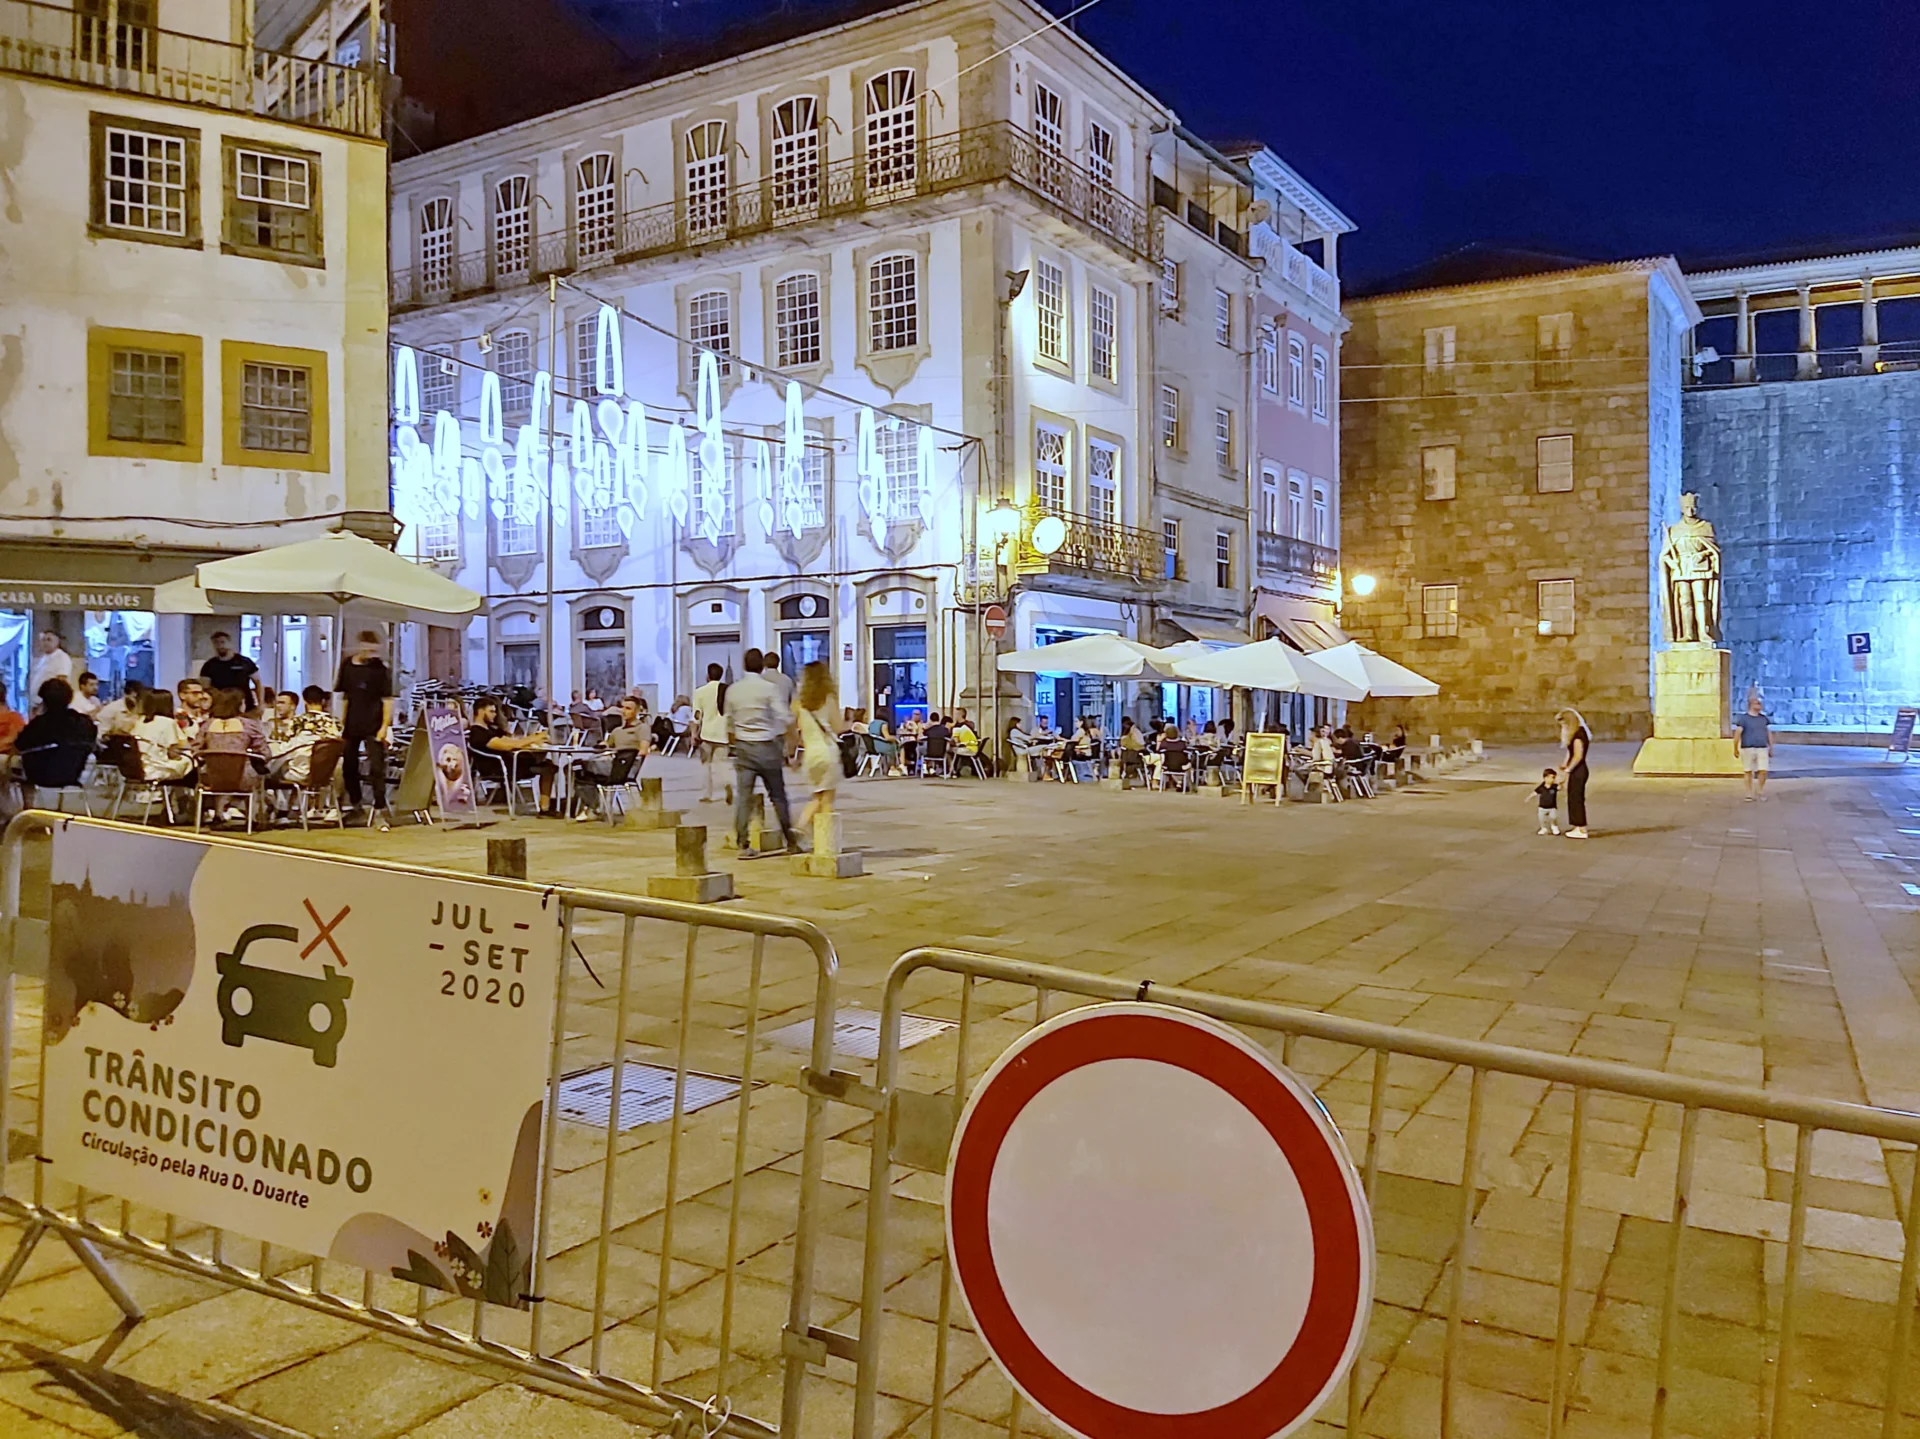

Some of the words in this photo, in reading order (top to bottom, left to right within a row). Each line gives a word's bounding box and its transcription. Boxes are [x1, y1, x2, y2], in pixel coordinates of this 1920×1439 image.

[0, 591, 36, 604] CASA
[43, 592, 72, 605] DOS
[78, 591, 141, 607] BALCÕES
[1851, 635, 1867, 653] P
[431, 900, 494, 934] JUL
[463, 939, 530, 973] SET
[440, 969, 525, 1008] 2020
[84, 1046, 262, 1120] TRÂNSITO
[82, 1089, 373, 1194] CONDICIONADO
[81, 1131, 158, 1168] Circulação
[160, 1156, 196, 1178] pela
[199, 1164, 229, 1188] Rua
[232, 1173, 249, 1193] D.
[252, 1178, 310, 1209] Duarte
